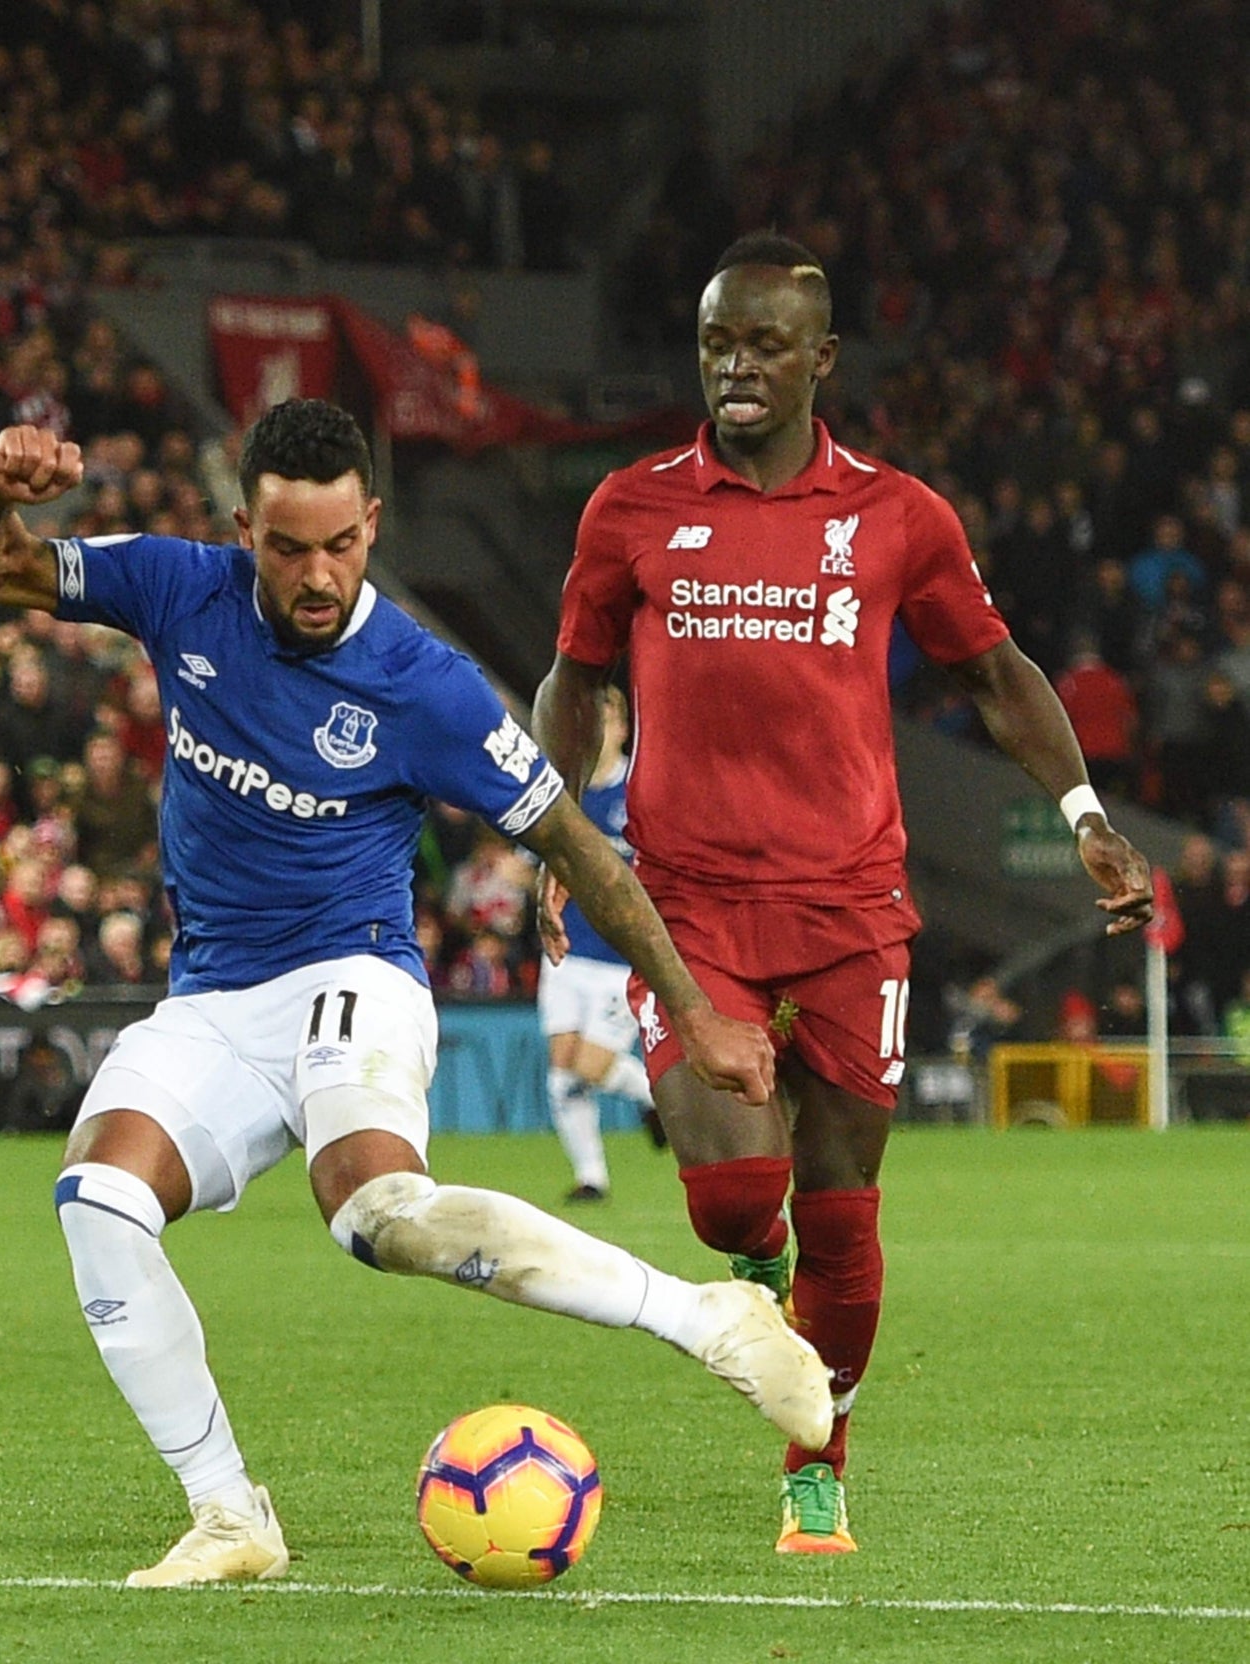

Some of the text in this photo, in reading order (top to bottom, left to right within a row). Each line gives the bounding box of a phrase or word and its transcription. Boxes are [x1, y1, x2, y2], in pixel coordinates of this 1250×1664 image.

[670, 578, 817, 611] Standard
[666, 611, 815, 643] Chartered
[169, 706, 348, 819] SportPesa
[307, 989, 359, 1046] 11
